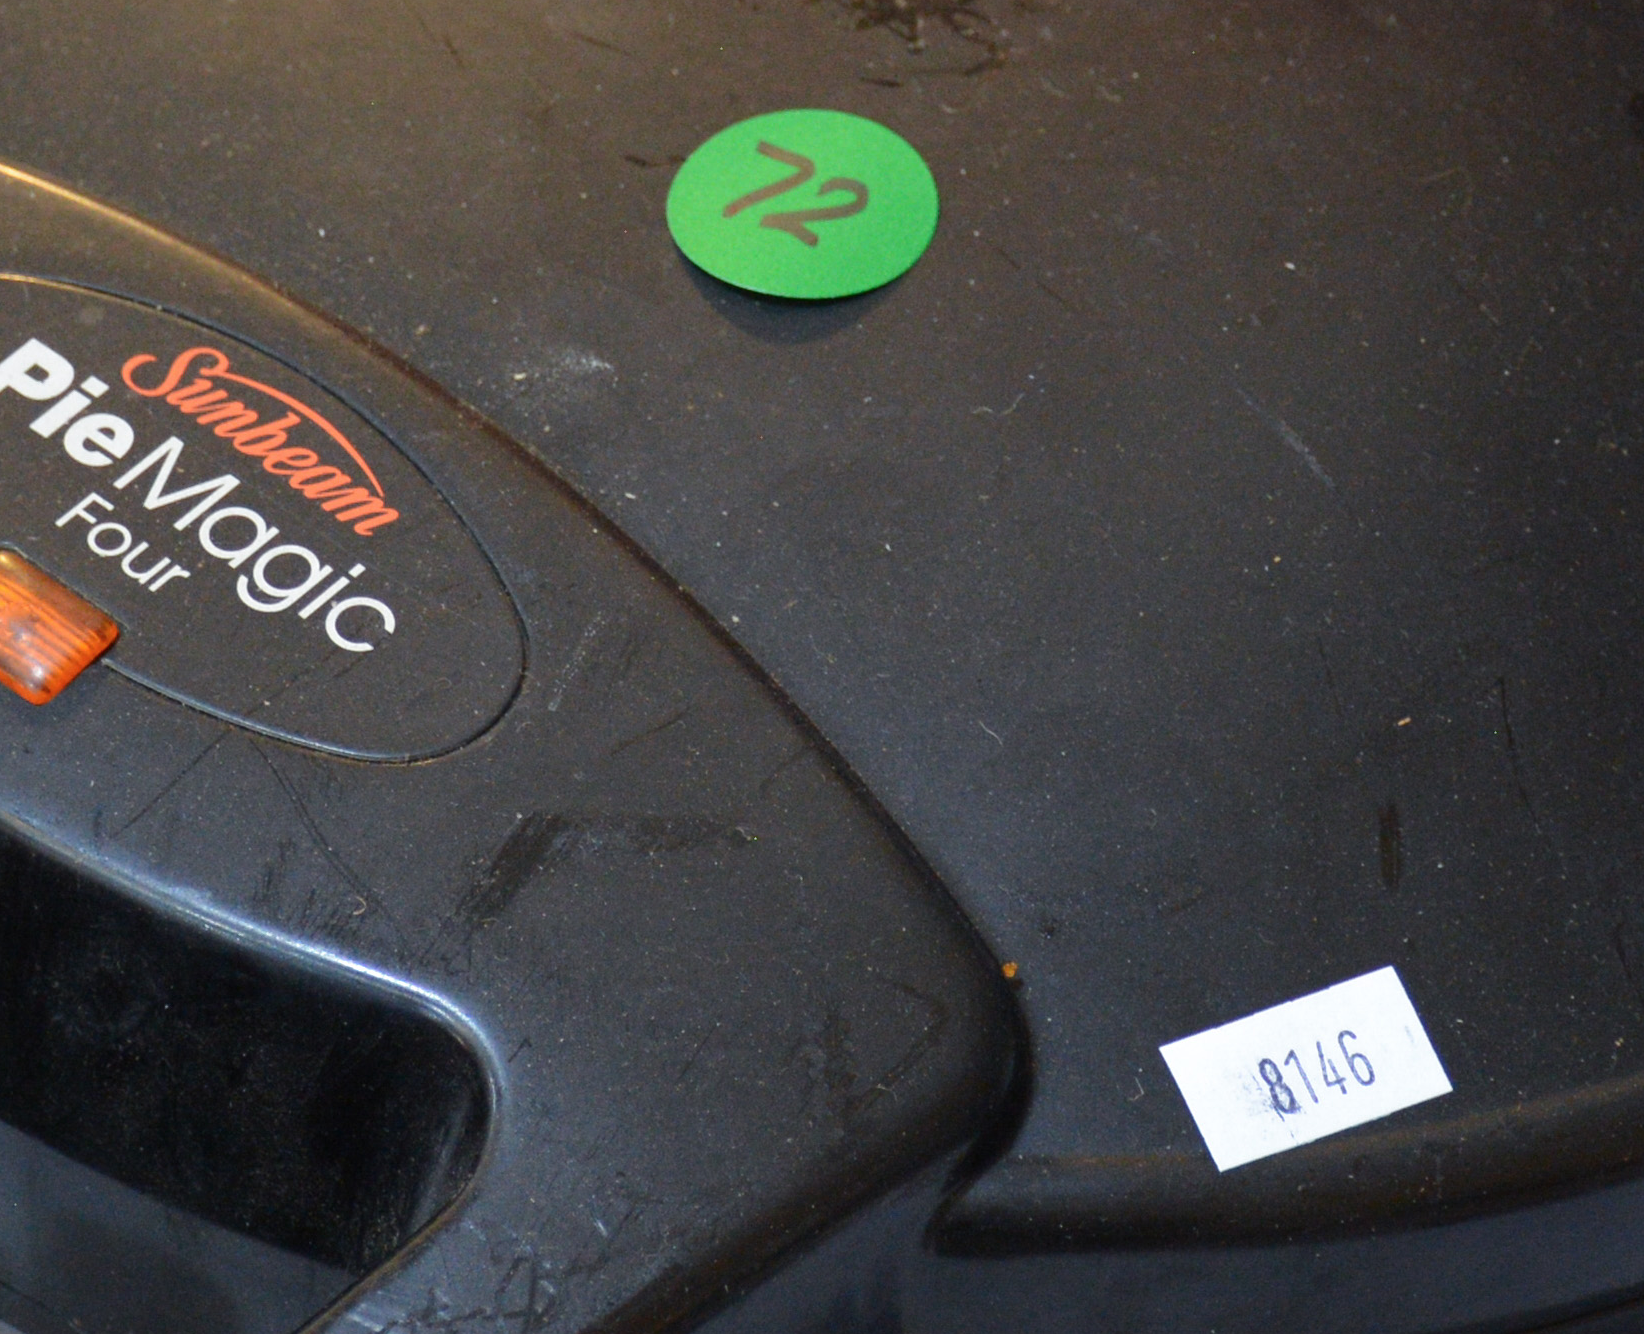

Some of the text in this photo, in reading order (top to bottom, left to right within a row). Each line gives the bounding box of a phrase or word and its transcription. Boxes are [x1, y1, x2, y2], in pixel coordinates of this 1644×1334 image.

[721, 139, 869, 248] 72
[121, 346, 400, 537] Sunbeam
[55, 490, 190, 595] Four
[1257, 1029, 1376, 1116] 8146
